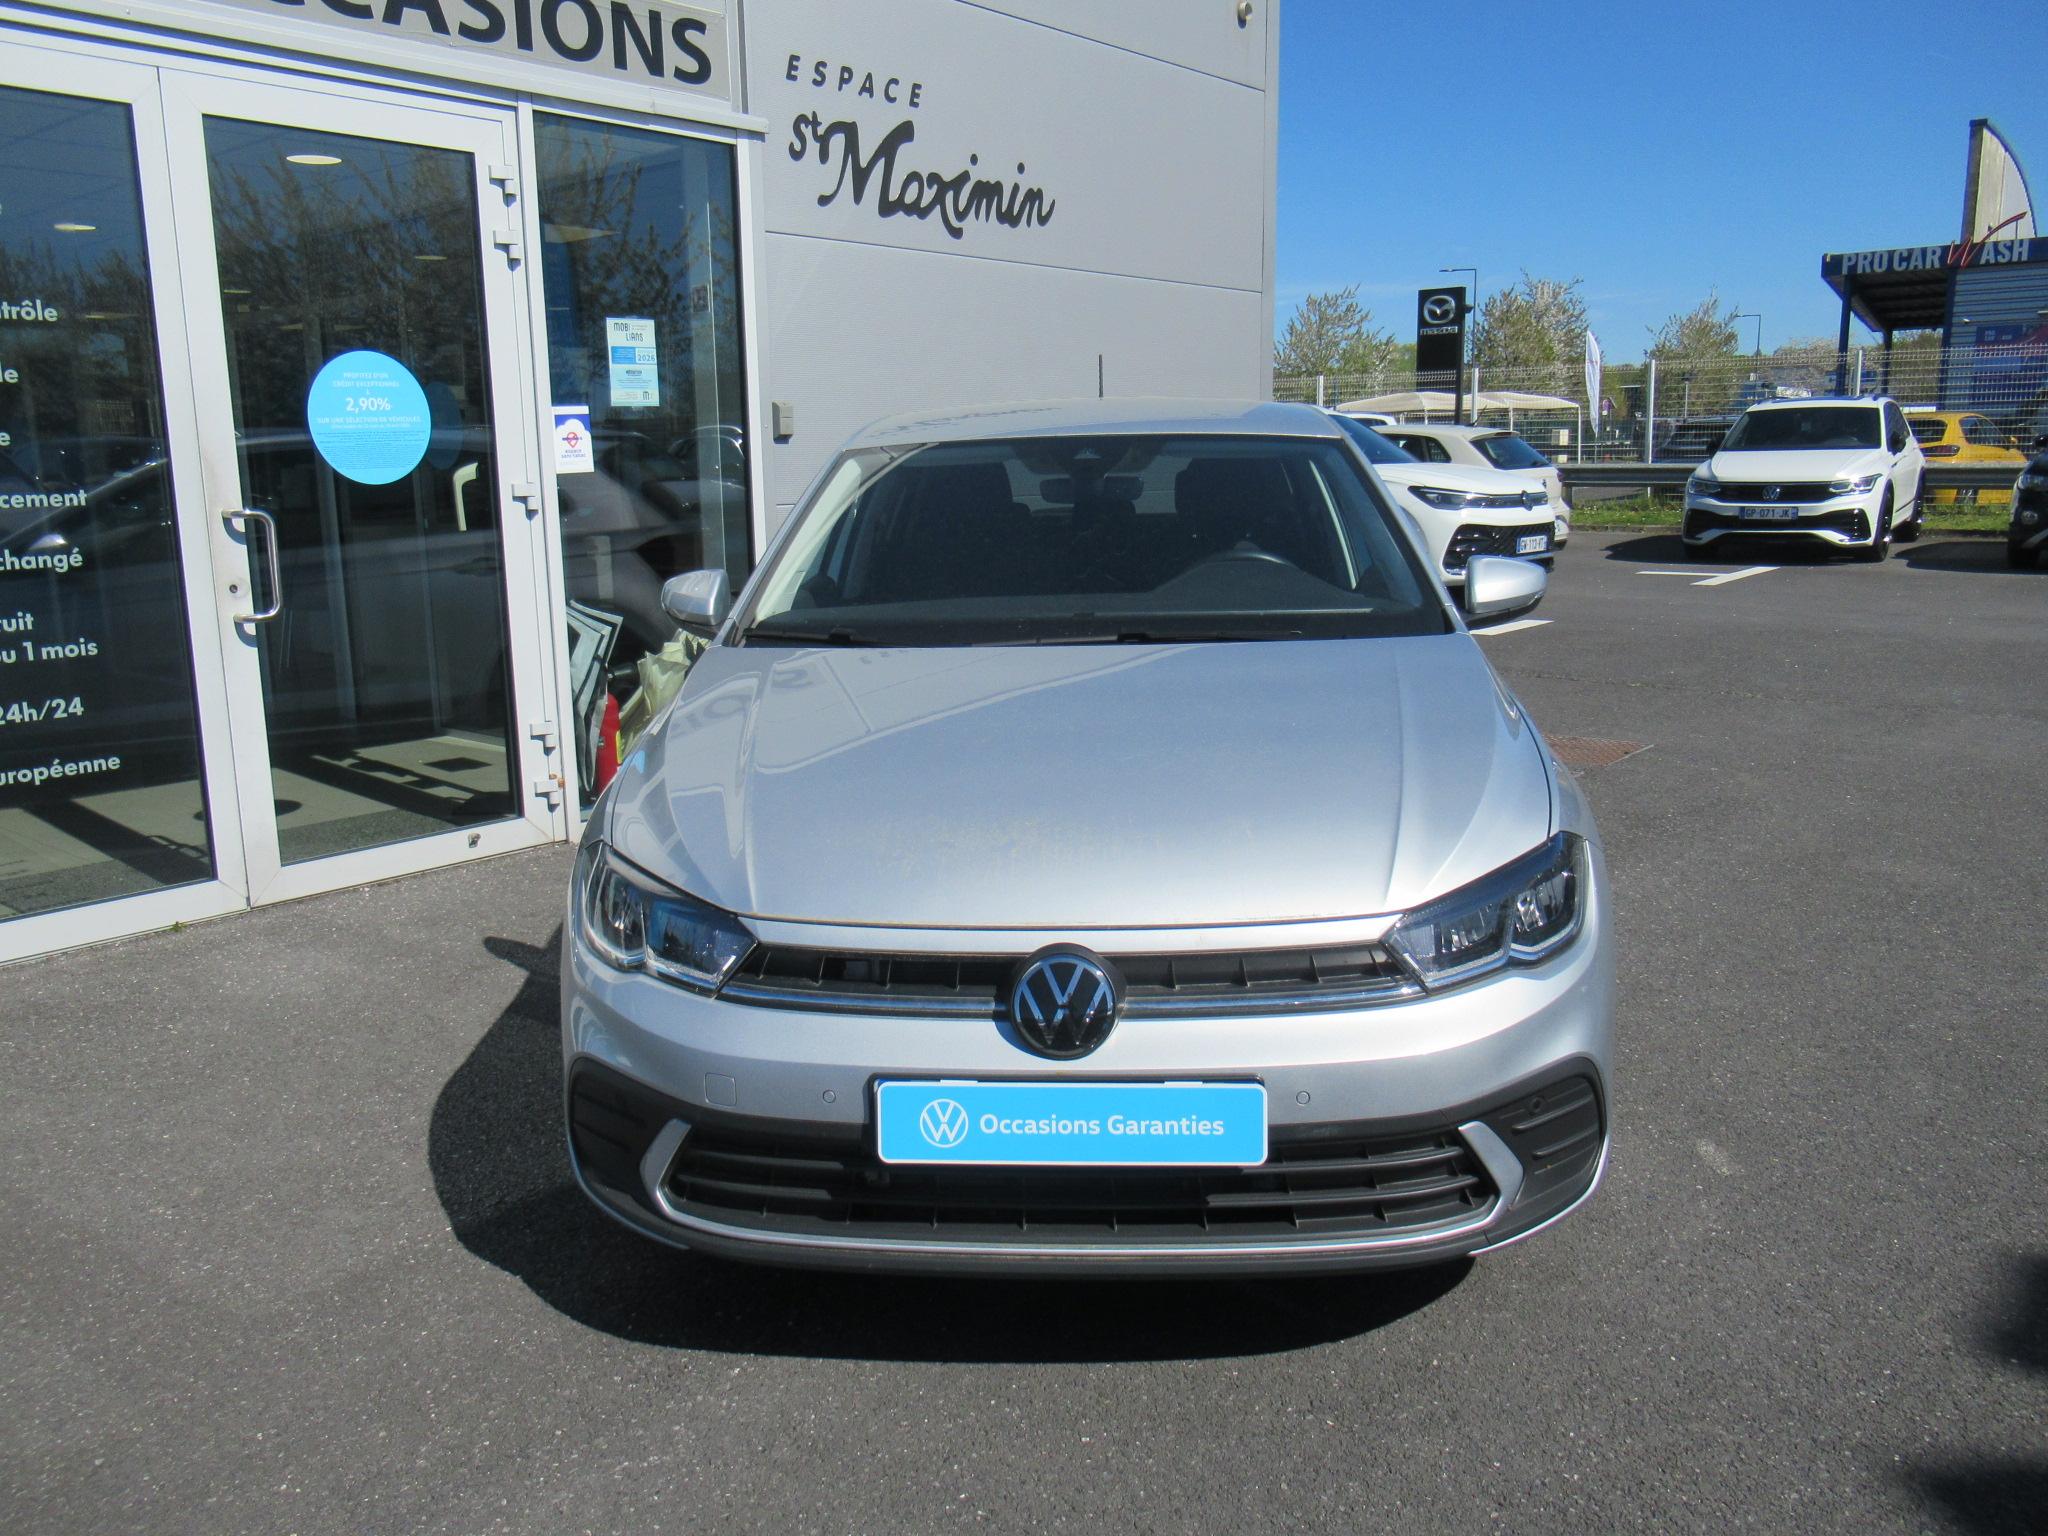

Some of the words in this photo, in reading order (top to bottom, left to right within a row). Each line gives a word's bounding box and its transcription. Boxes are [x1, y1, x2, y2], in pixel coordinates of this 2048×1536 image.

[785, 54, 923, 108] ESPACE
[817, 120, 1056, 240] Maximin
[1841, 251, 1888, 275] PRO
[1892, 245, 1943, 272] CAR
[0, 299, 58, 321] trôle
[346, 397, 391, 414] 2,90%
[0, 611, 34, 632] uit
[22, 641, 34, 661] 1
[41, 638, 98, 660] mois
[979, 1114, 1101, 1135] Occasions
[1107, 1114, 1225, 1136] Garanties
